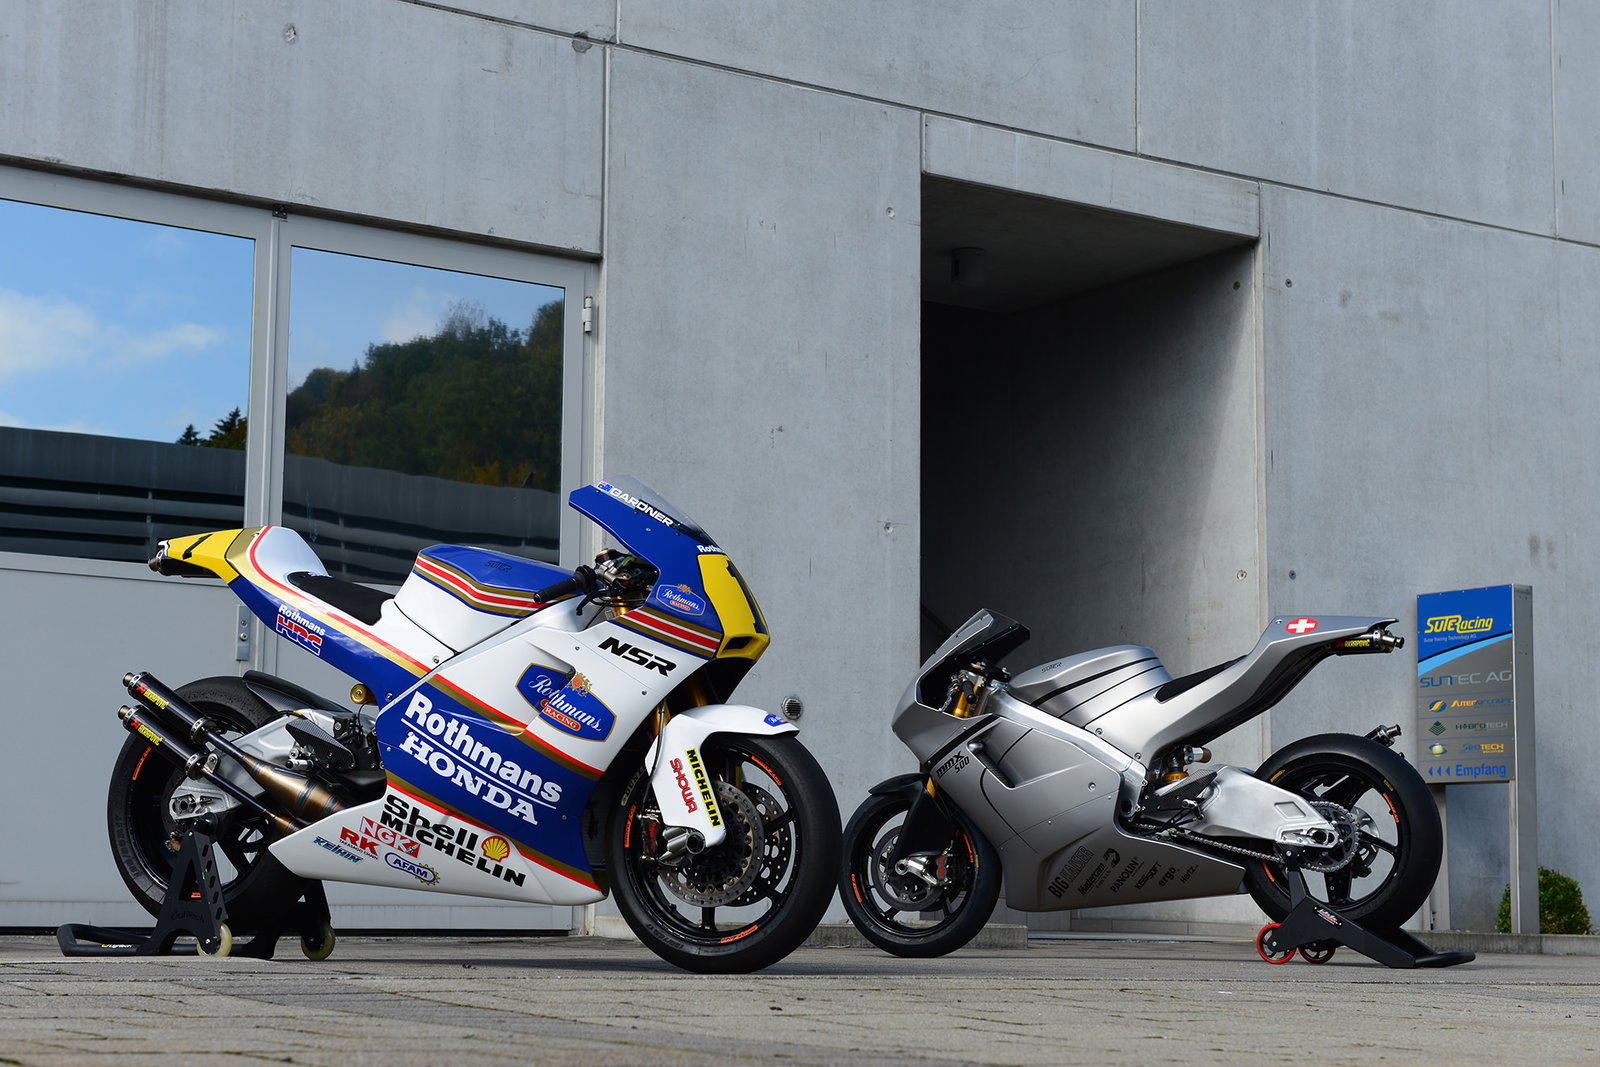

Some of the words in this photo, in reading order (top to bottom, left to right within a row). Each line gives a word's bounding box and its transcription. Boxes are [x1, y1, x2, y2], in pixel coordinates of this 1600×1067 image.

[610, 487, 674, 527] GARDNER
[662, 588, 700, 611] Rothmans
[276, 613, 323, 656] HRC
[278, 604, 326, 636] Rothmans
[597, 636, 678, 678] NSR
[1486, 670, 1513, 683] AG
[528, 674, 602, 732] Rothmans
[545, 706, 578, 729] RACING
[404, 690, 563, 803] Rothmans
[954, 755, 970, 774] 500
[399, 733, 539, 825] HONDA
[669, 757, 698, 813] SHOWA
[686, 748, 721, 827] MICHELIN
[1455, 763, 1508, 779] Empfang
[360, 816, 413, 854] NGK
[384, 794, 479, 851] Shell
[339, 826, 381, 857] RK
[379, 811, 527, 888] MICHELIN
[392, 857, 429, 879] AFAM
[1047, 876, 1070, 899] BIG
[1059, 845, 1095, 884] KAISER
[1078, 862, 1107, 896] Mastercam
[1109, 859, 1140, 893] PANOLIN
[1158, 866, 1177, 888] ergo
[1180, 866, 1196, 884] Hertz
